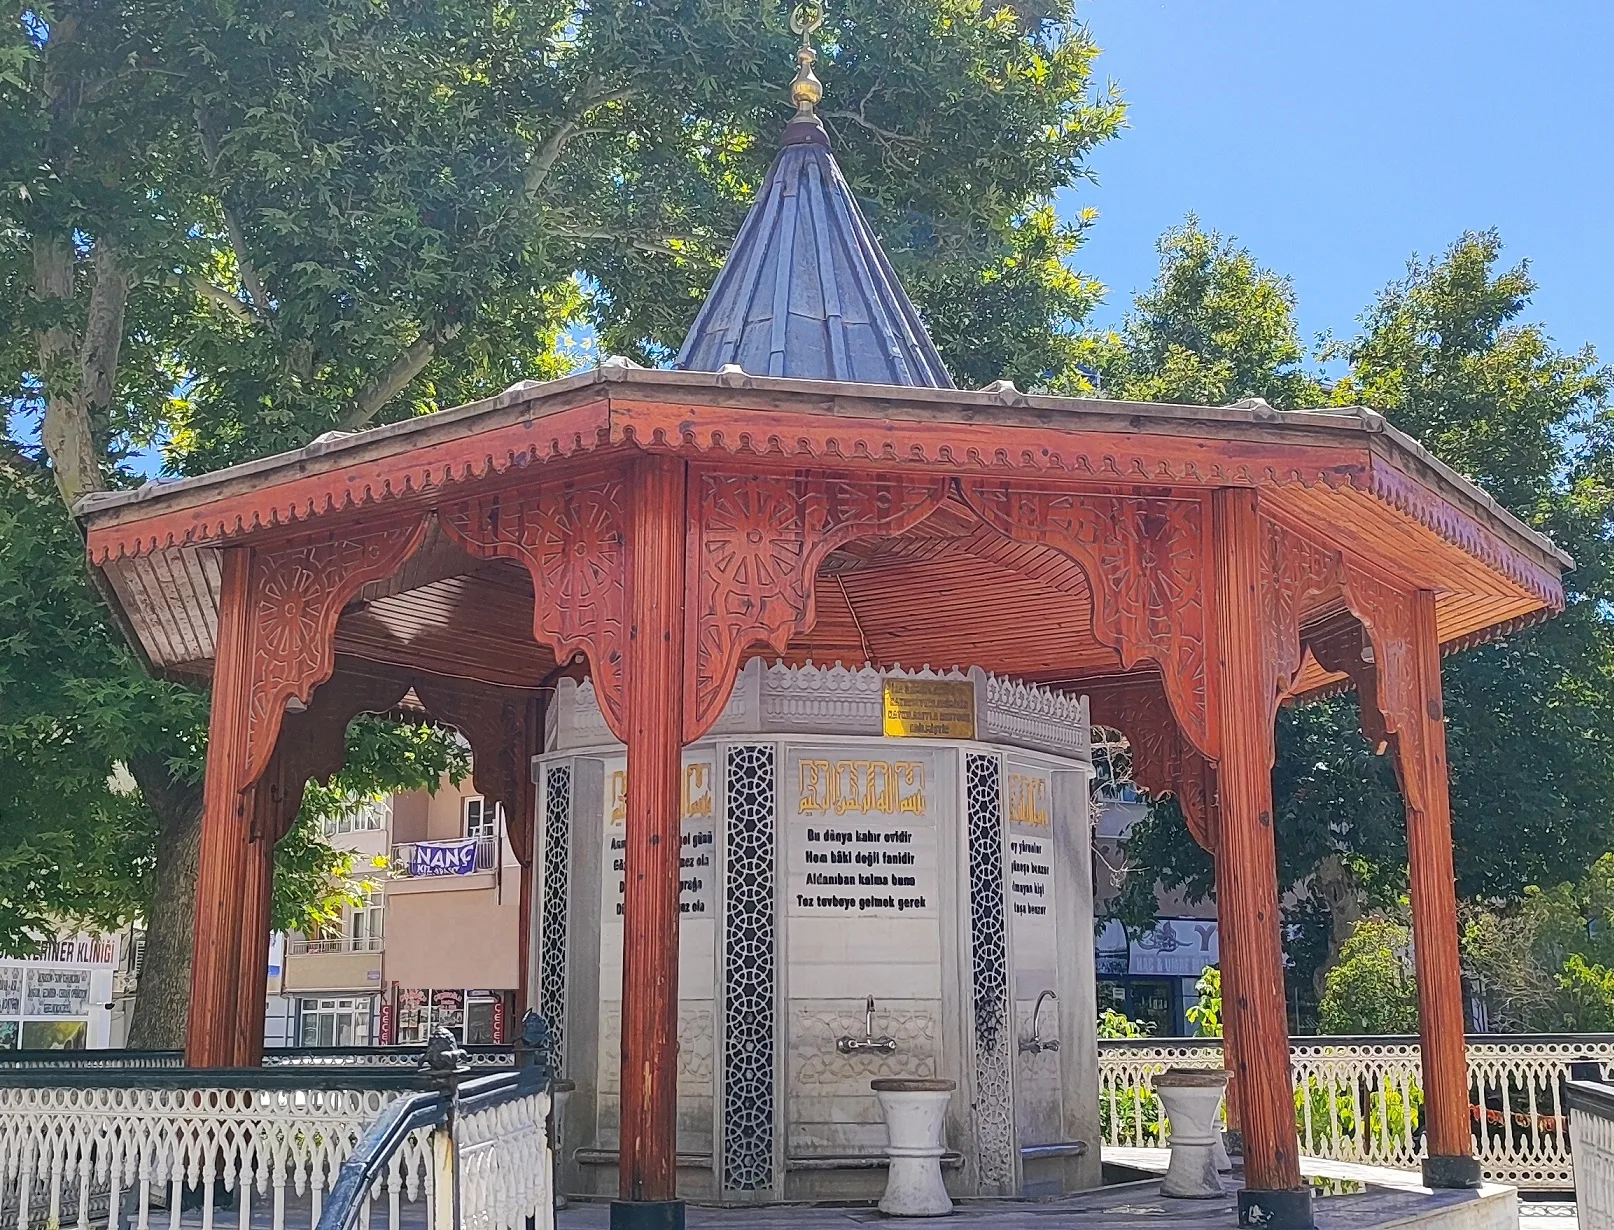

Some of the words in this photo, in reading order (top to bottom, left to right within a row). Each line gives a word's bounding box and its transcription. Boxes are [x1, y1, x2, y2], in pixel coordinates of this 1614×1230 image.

[807, 828, 820, 842] Bu
[823, 829, 853, 846] dünya
[855, 830, 882, 843] kahır
[696, 853, 709, 867] ola
[855, 851, 880, 867] değil
[882, 851, 915, 865] fanidir
[691, 902, 705, 914] ola
[897, 895, 926, 912] gerek
